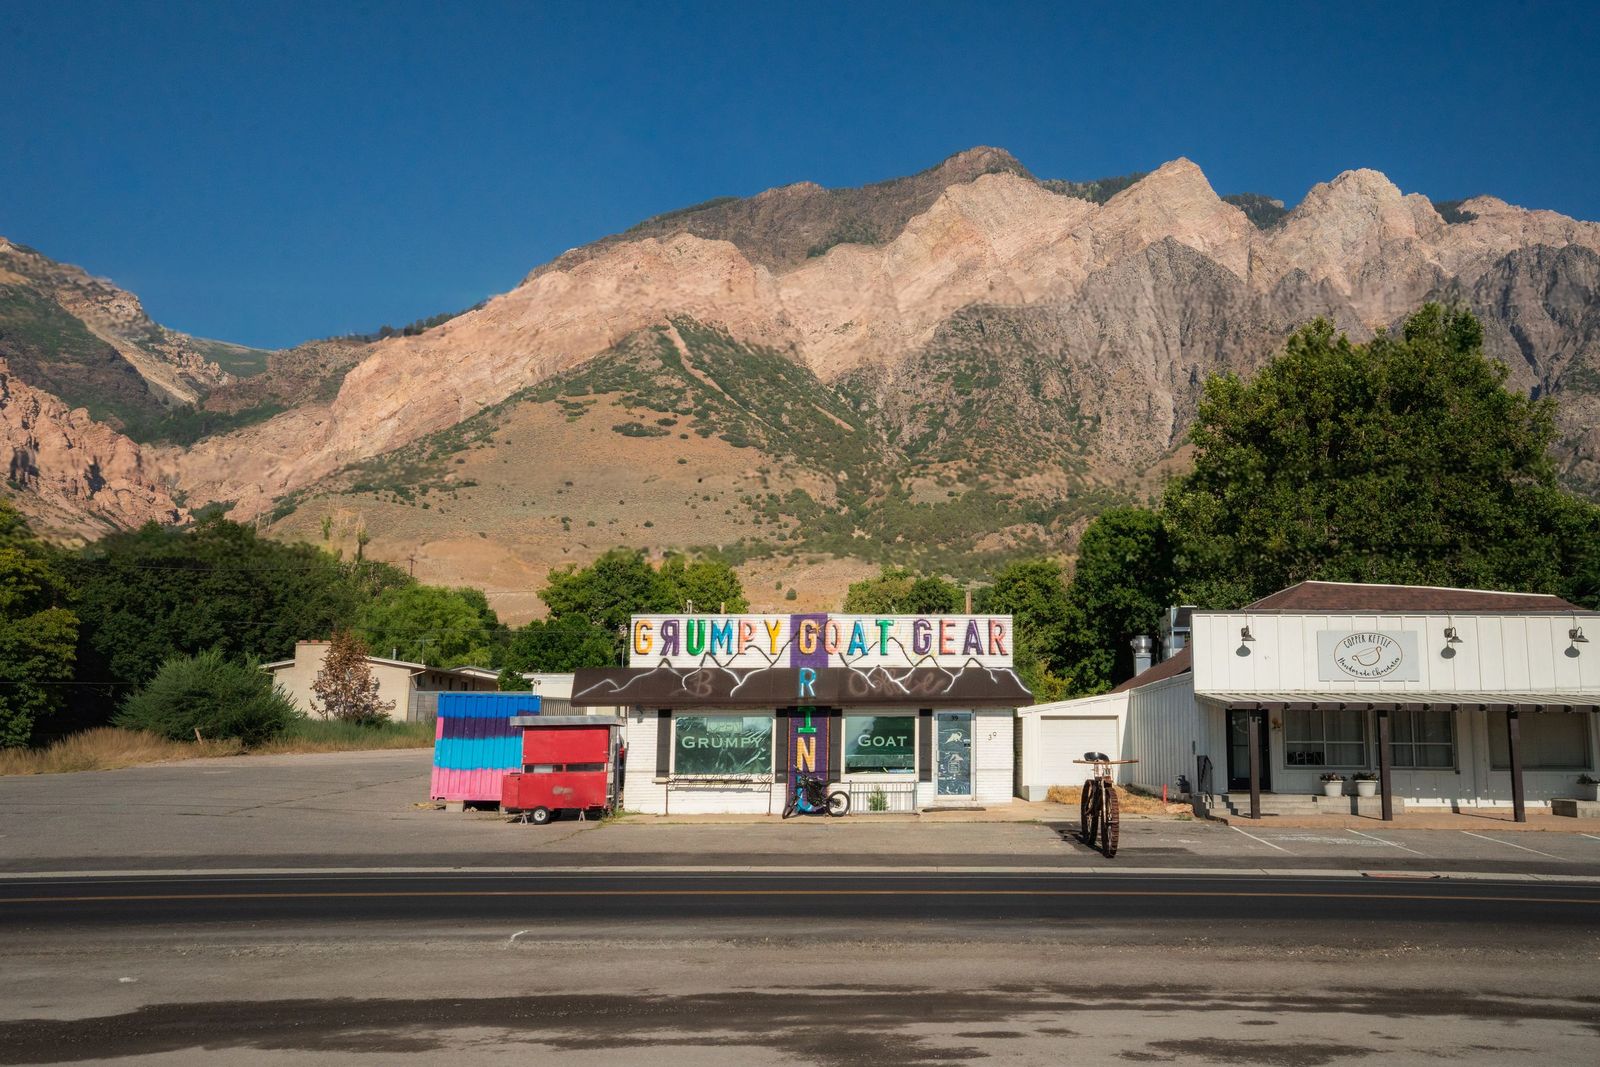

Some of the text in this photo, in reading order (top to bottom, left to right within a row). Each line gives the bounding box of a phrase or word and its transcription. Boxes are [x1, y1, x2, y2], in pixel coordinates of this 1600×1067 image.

[798, 618, 895, 656] GOAT
[913, 618, 1009, 656] GEAR
[1343, 634, 1392, 649] COPPER KETTLE
[681, 735, 763, 749] GRUMPY
[857, 734, 908, 747] GOAT
[1288, 751, 1323, 765] OPEN
